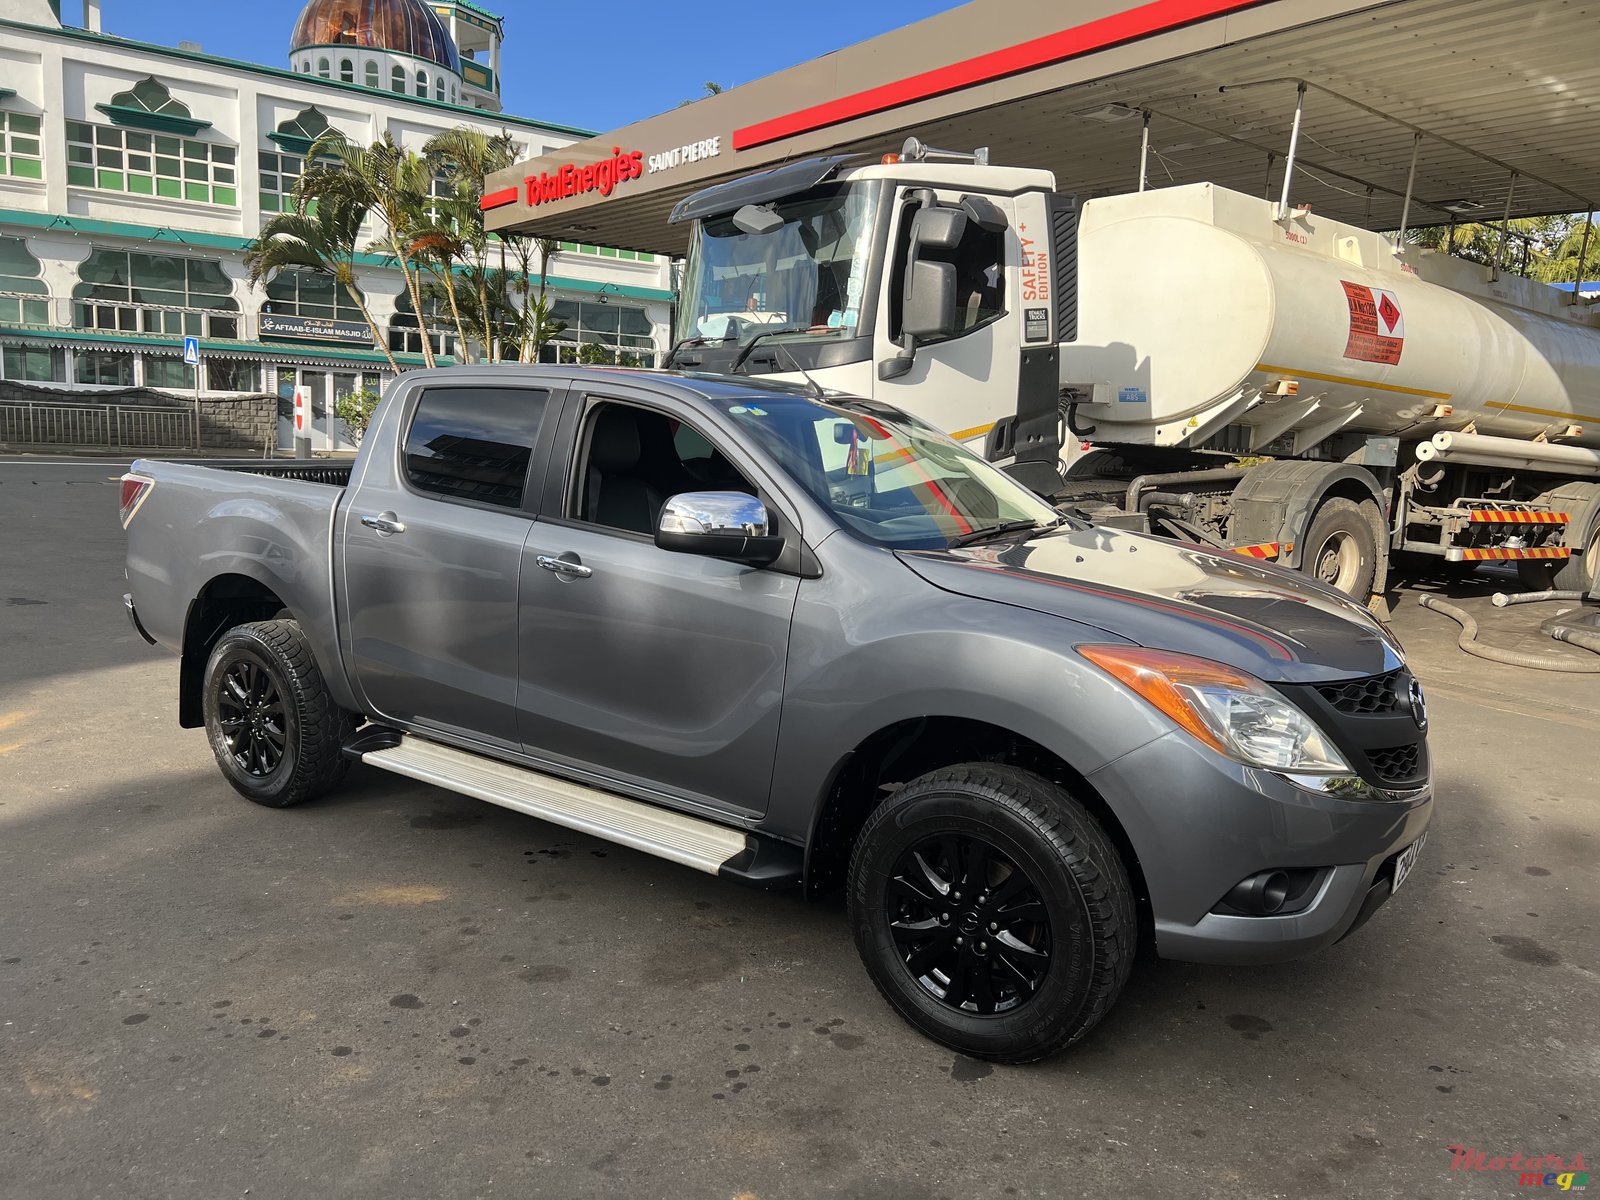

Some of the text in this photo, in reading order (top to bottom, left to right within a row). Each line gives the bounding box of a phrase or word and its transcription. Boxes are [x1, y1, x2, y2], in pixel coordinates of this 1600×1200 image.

[524, 147, 643, 206] TotalEnergies
[648, 135, 721, 174] SAINT PIERRE
[1020, 238, 1036, 301] SAFETY
[1037, 253, 1049, 301] EDITION
[275, 324, 334, 335] AFTAAB-E-ISLAM
[335, 329, 361, 338] MASJID
